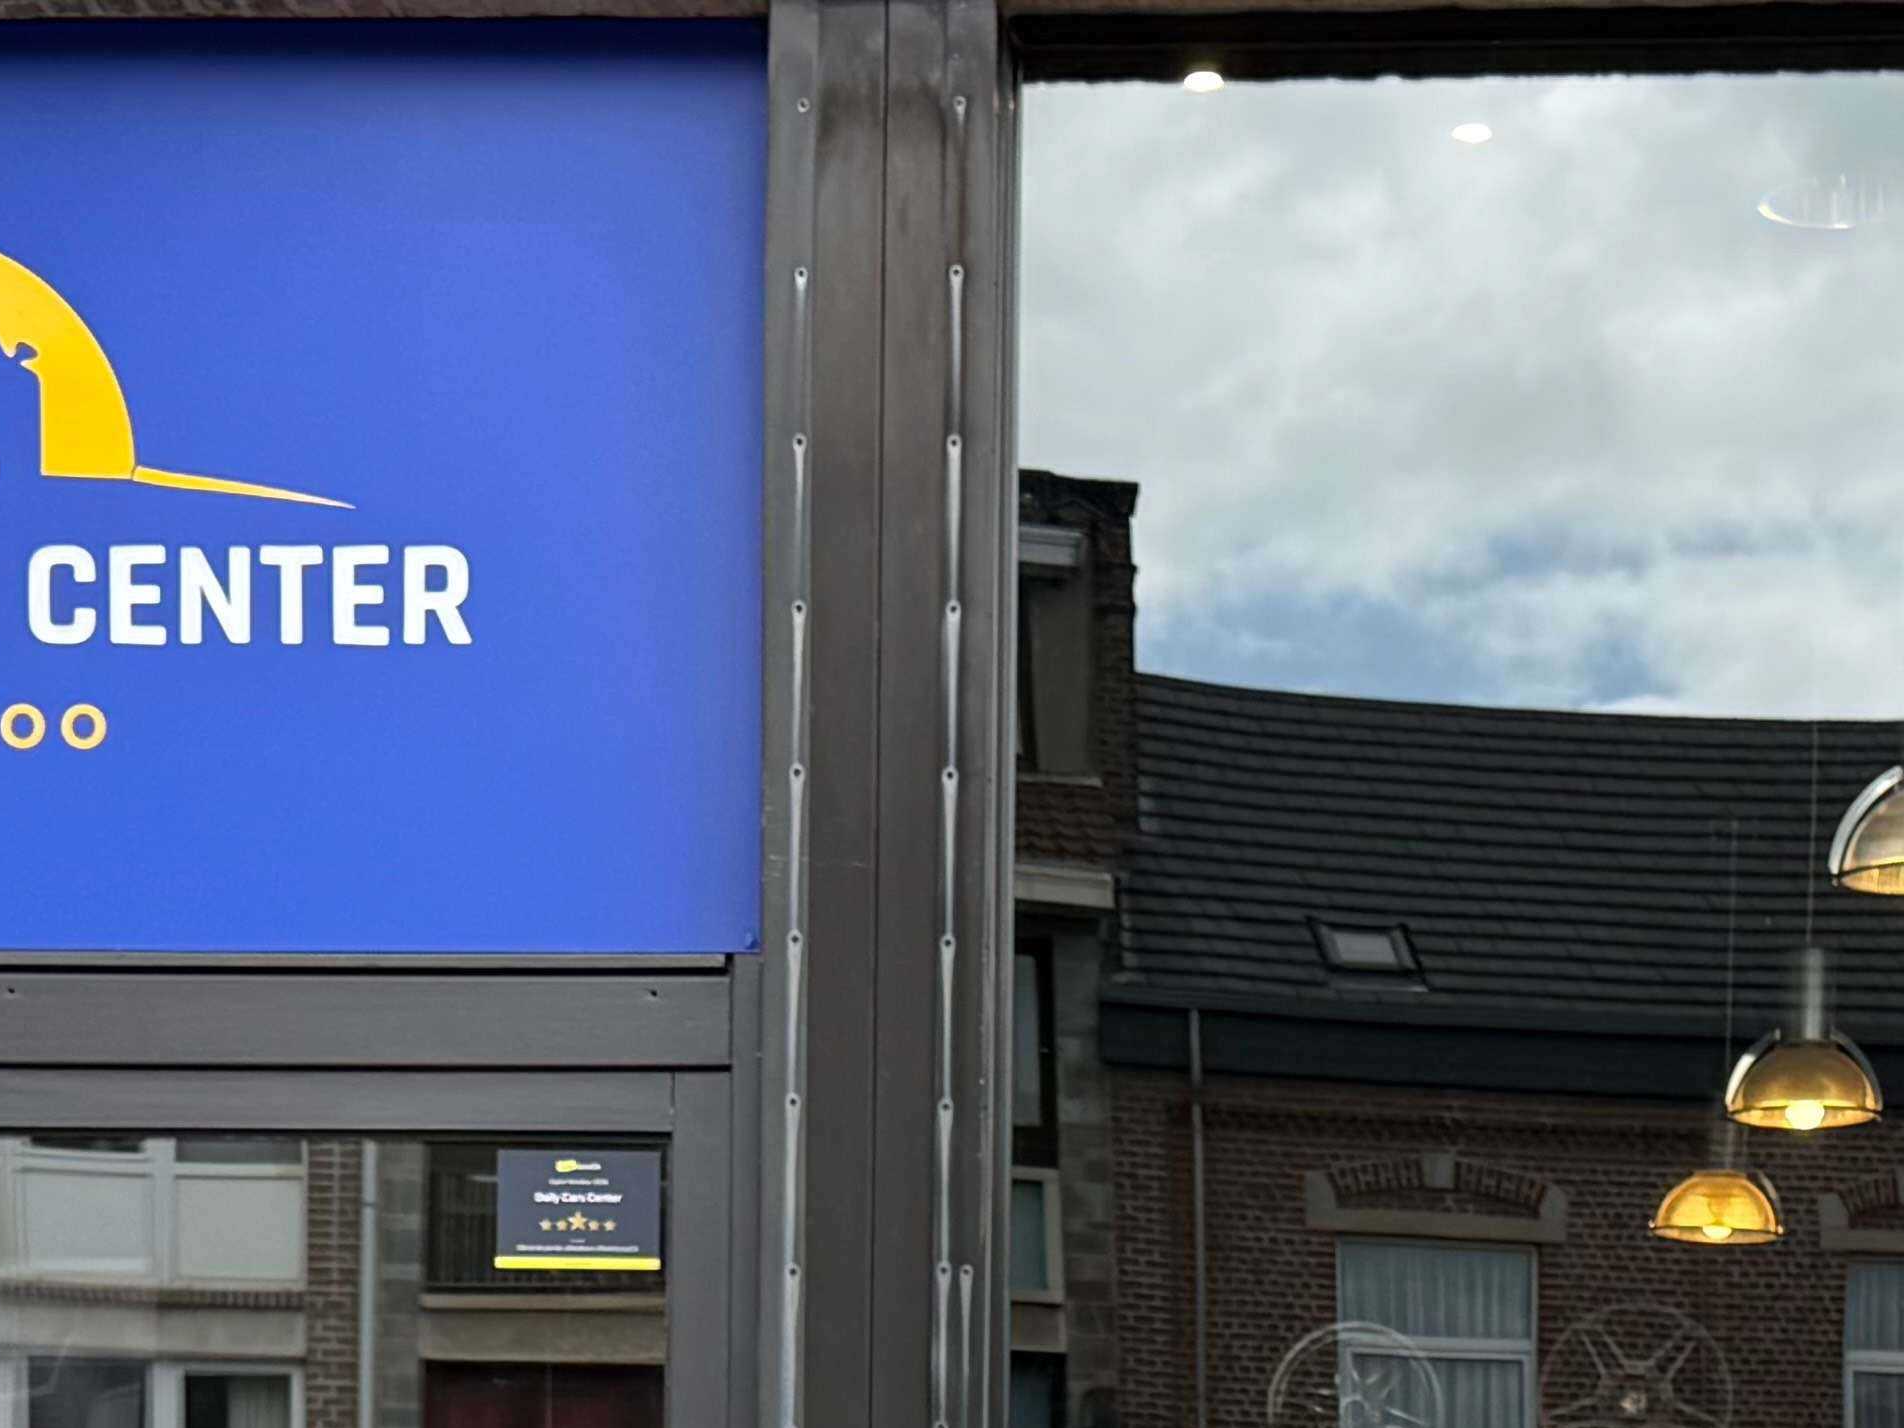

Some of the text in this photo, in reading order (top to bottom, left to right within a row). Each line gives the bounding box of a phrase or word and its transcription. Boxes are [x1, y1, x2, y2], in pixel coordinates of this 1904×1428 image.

[27, 543, 473, 647] CENTER
[533, 1191, 623, 1204] Daily Cars Center
